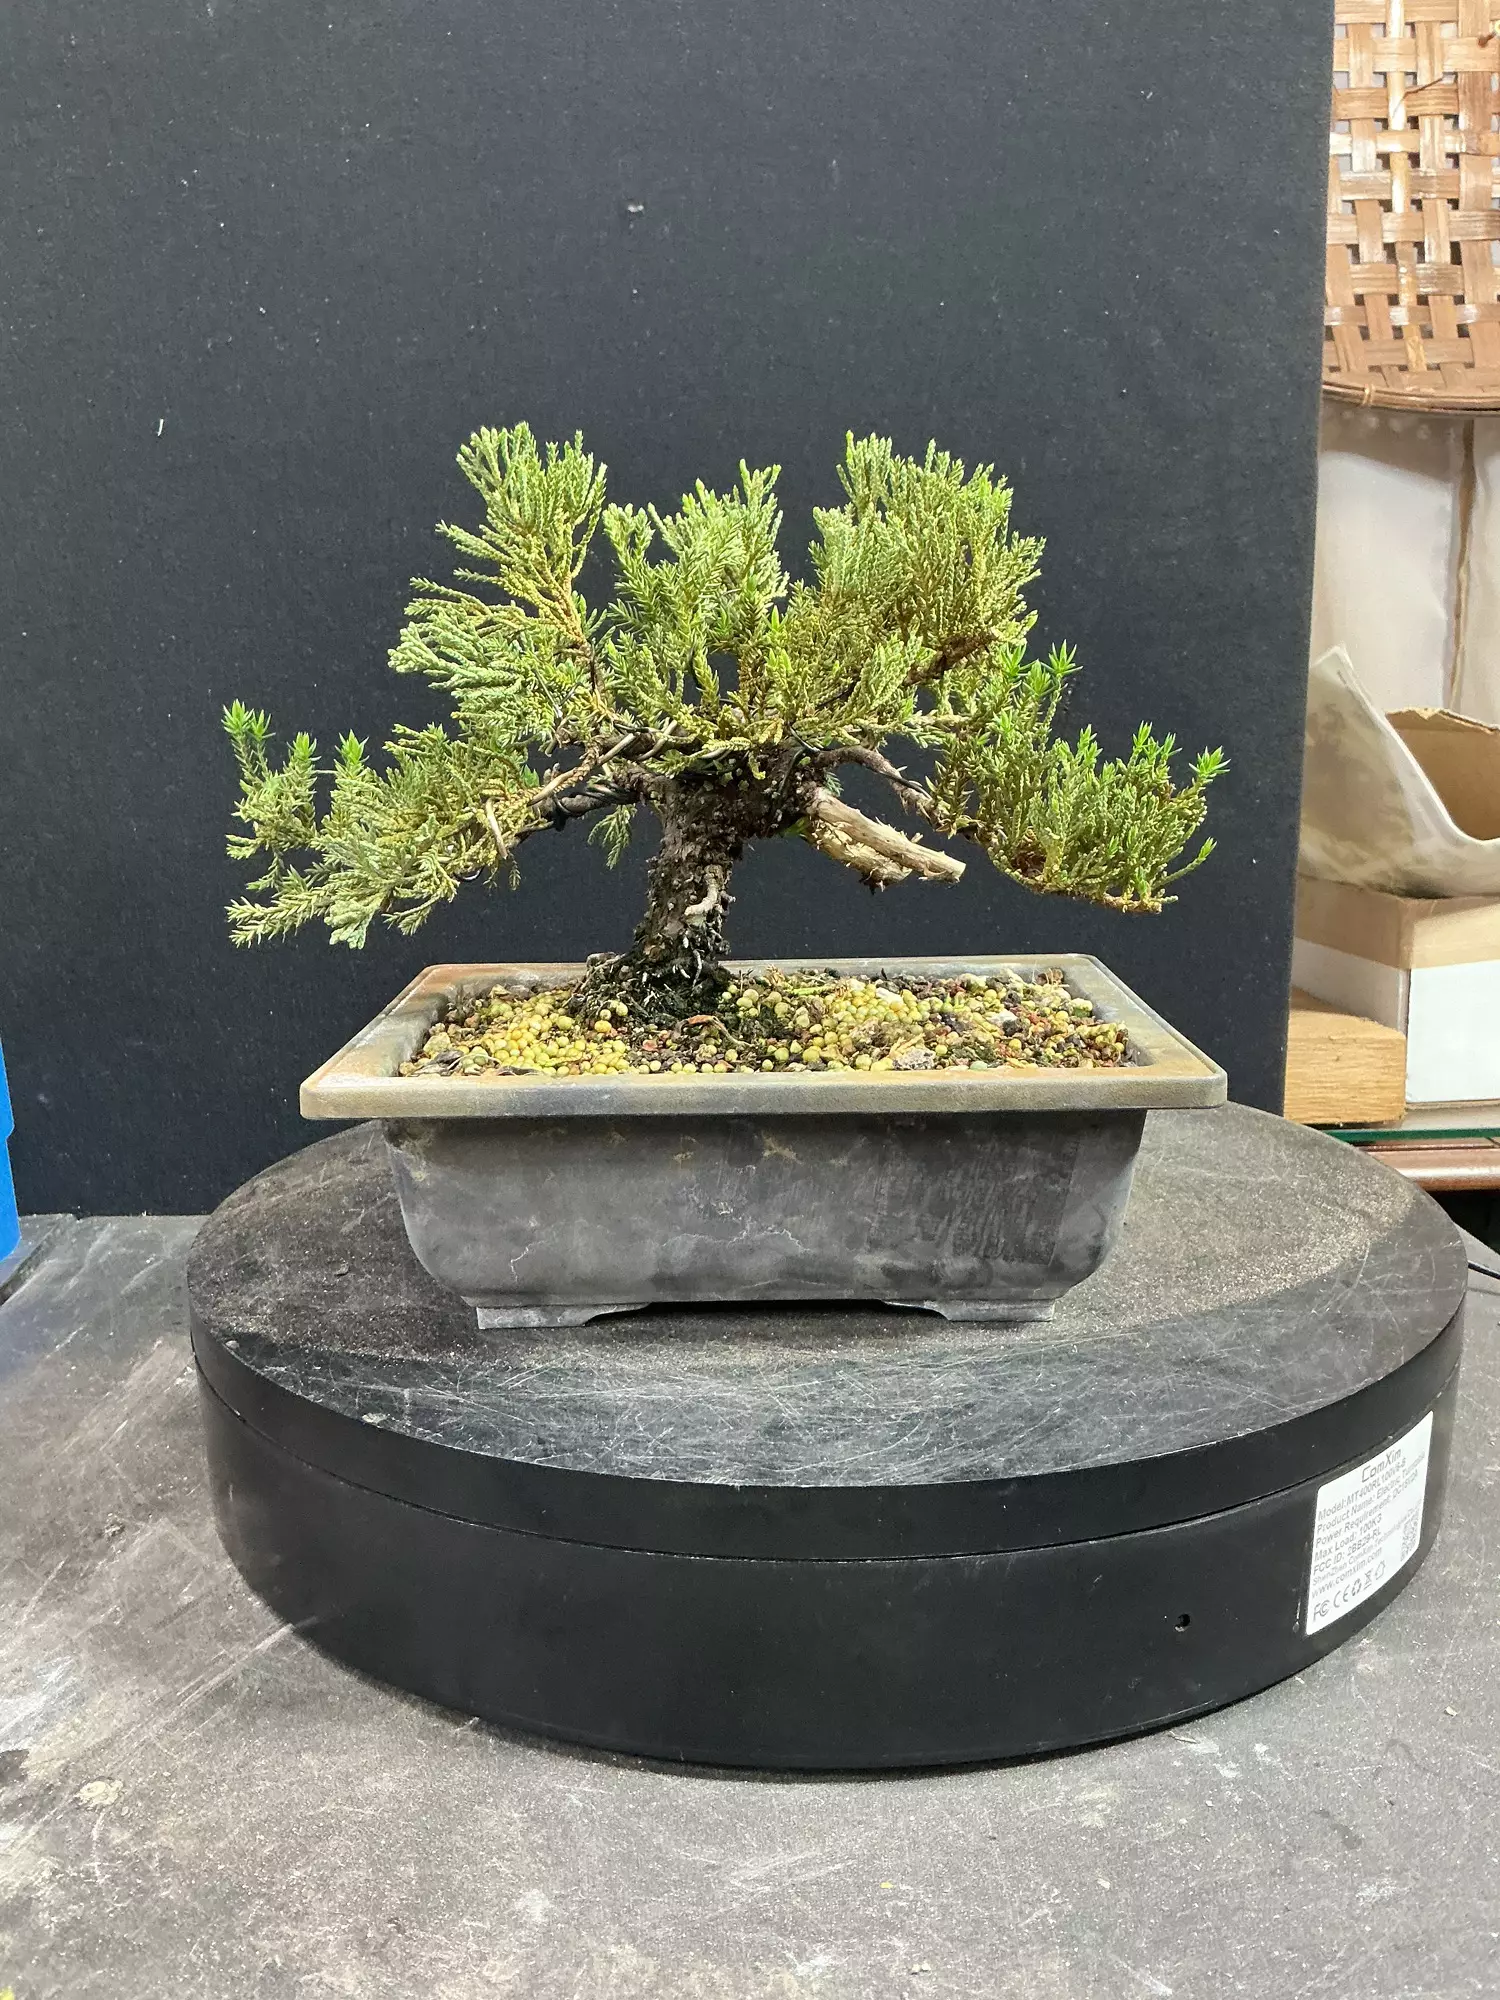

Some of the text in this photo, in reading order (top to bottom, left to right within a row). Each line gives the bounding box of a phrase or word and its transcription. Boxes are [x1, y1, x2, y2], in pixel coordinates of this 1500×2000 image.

[1361, 1449, 1401, 1483] ComXim
[1316, 1510, 1350, 1535] Product
[1350, 1493, 1376, 1517] Name:
[1314, 1547, 1333, 1562] Max
[1334, 1531, 1357, 1552] Load:
[1315, 1528, 1343, 1549] Power
[1311, 1546, 1383, 1599] www.comxim.com
[1313, 1558, 1332, 1576] FCC
[1333, 1551, 1346, 1566] ID:
